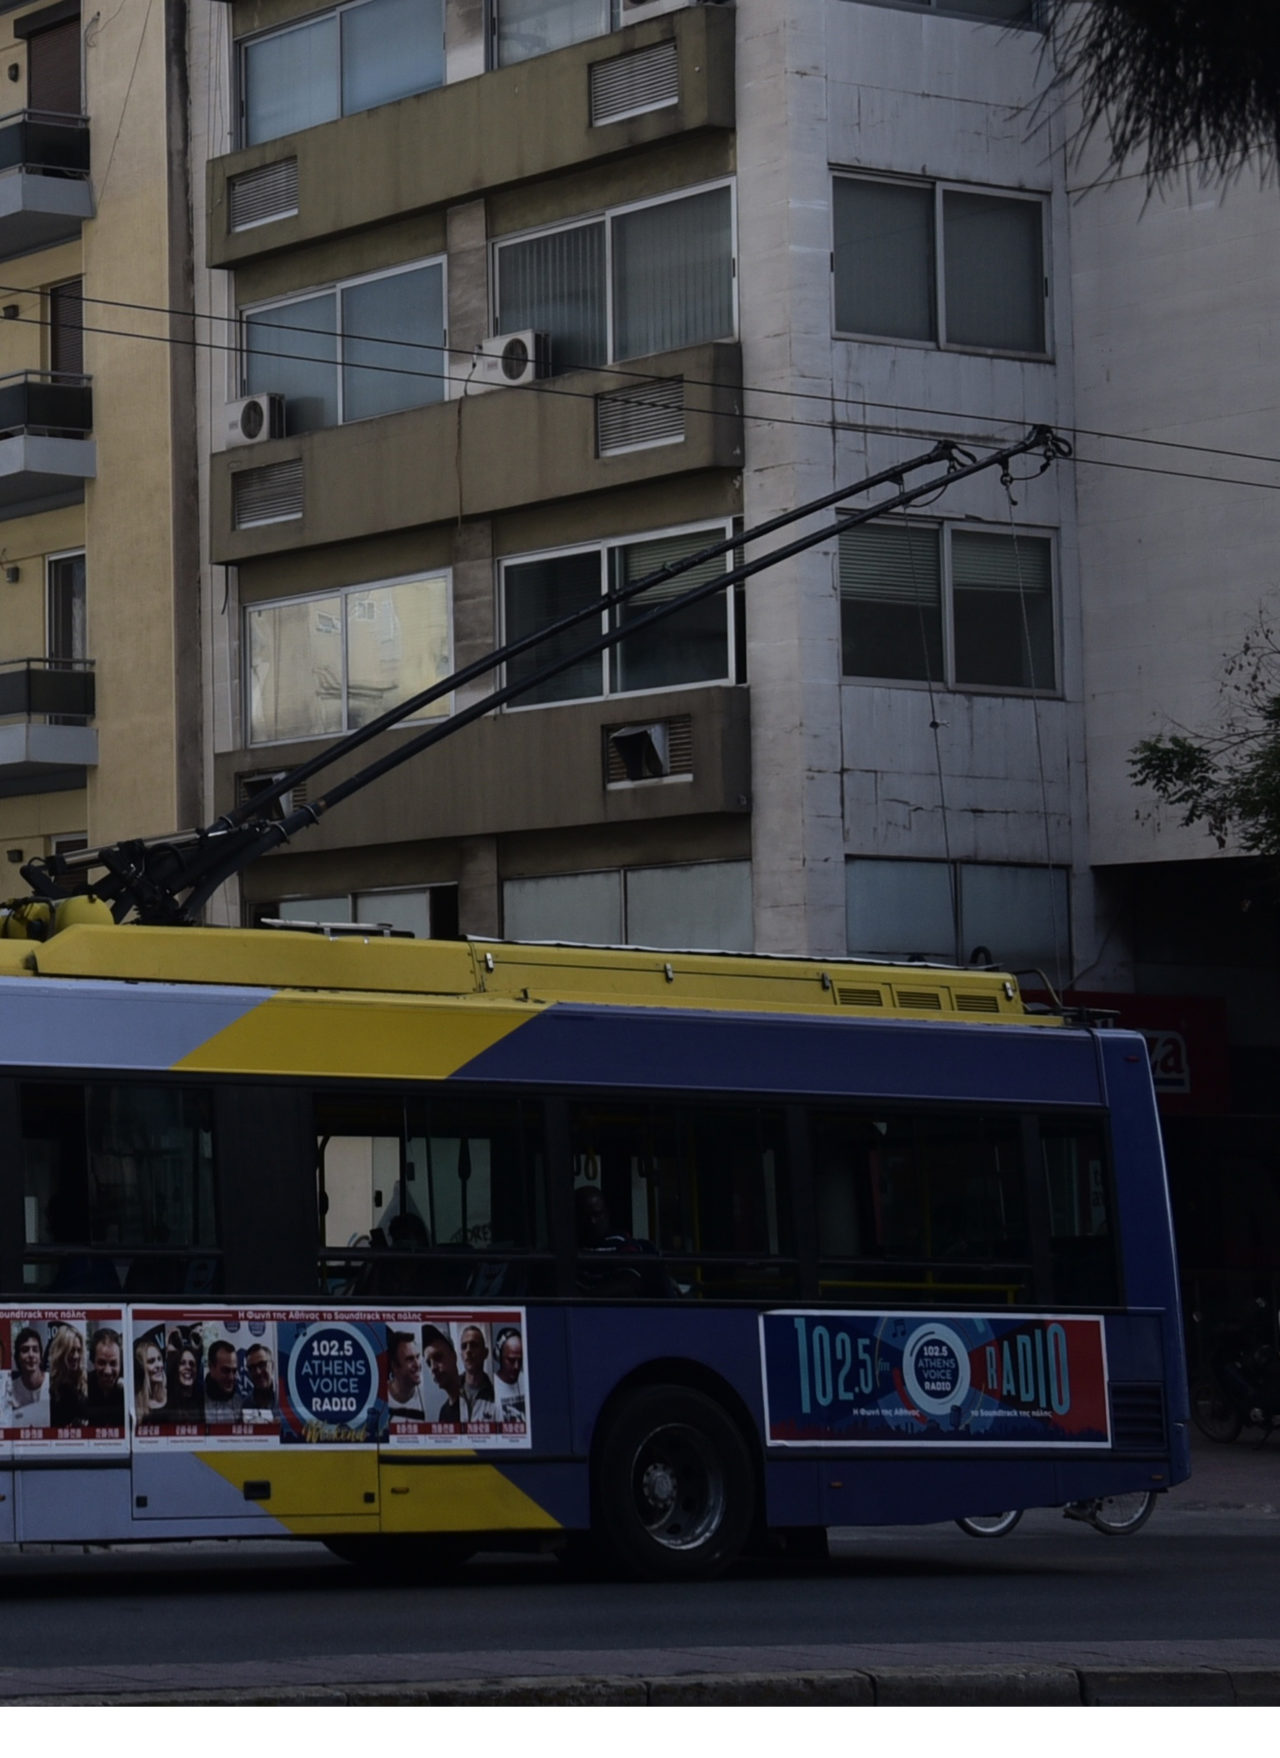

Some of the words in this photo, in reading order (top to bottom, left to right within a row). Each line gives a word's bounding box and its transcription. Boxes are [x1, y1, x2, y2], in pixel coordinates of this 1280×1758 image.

[44, 1310, 59, 1320] της
[238, 1311, 245, 1321] Η
[246, 1311, 270, 1321] Φωνή
[272, 1311, 286, 1321] της
[288, 1311, 320, 1321] Αθήνας
[323, 1311, 332, 1321] το
[334, 1311, 380, 1321] Soundtrack
[382, 1311, 396, 1321] της
[312, 1340, 353, 1356] 102.5
[923, 1345, 948, 1357] 102.5
[301, 1360, 366, 1376] ATHENS
[794, 1317, 873, 1414] 102.5
[918, 1358, 955, 1368] ATHENS
[985, 1323, 1071, 1416] RADIO
[922, 1369, 952, 1380] VOICE
[308, 1377, 359, 1393] VOICE
[924, 1381, 951, 1391] RADIO
[312, 1397, 357, 1412] RADIO
